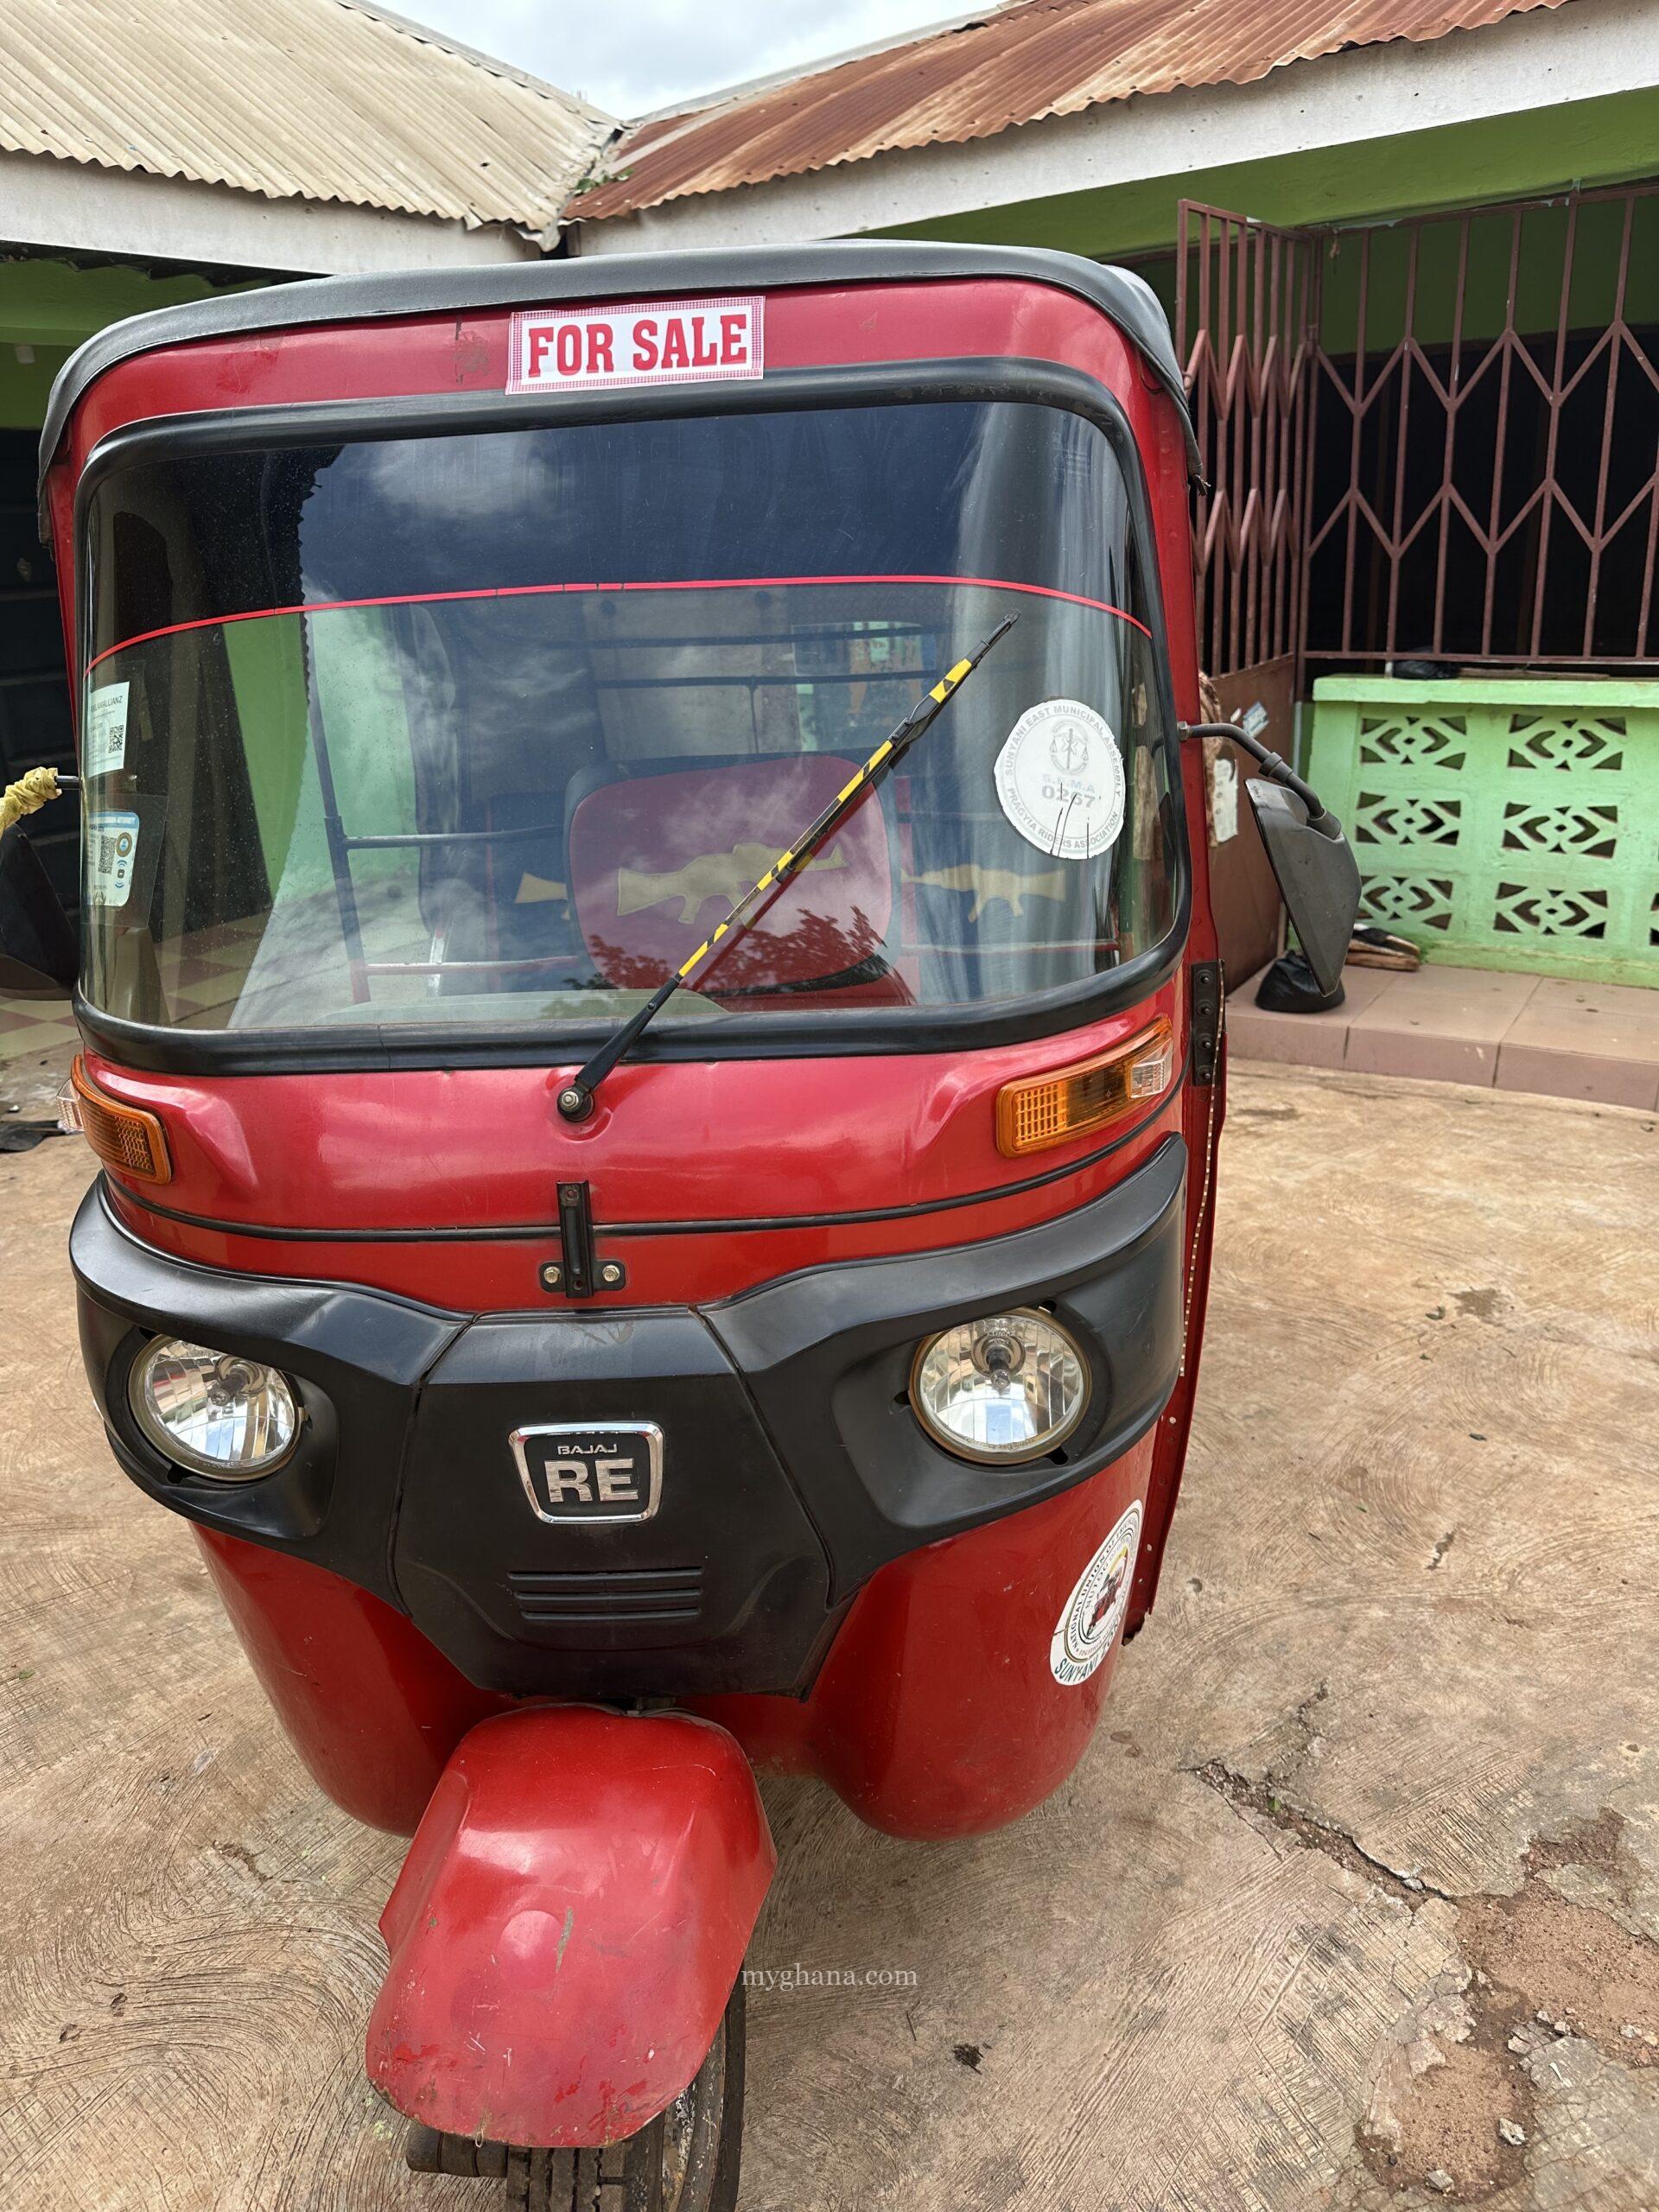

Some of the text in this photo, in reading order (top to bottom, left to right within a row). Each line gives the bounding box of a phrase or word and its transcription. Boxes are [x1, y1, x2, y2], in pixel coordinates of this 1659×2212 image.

[528, 314, 747, 378] FOR SALE
[1005, 704, 1122, 798] SUNYANI EAST MUNICIPAL ASSEMBLY
[1038, 828, 1071, 849] RIDERS
[1074, 810, 1118, 849] ASSOCIATION
[557, 1444, 618, 1455] BAJAJ
[544, 1458, 639, 1503] RE
[1081, 1554, 1105, 1597] UNION
[1054, 1657, 1099, 1682] SUNYANI
